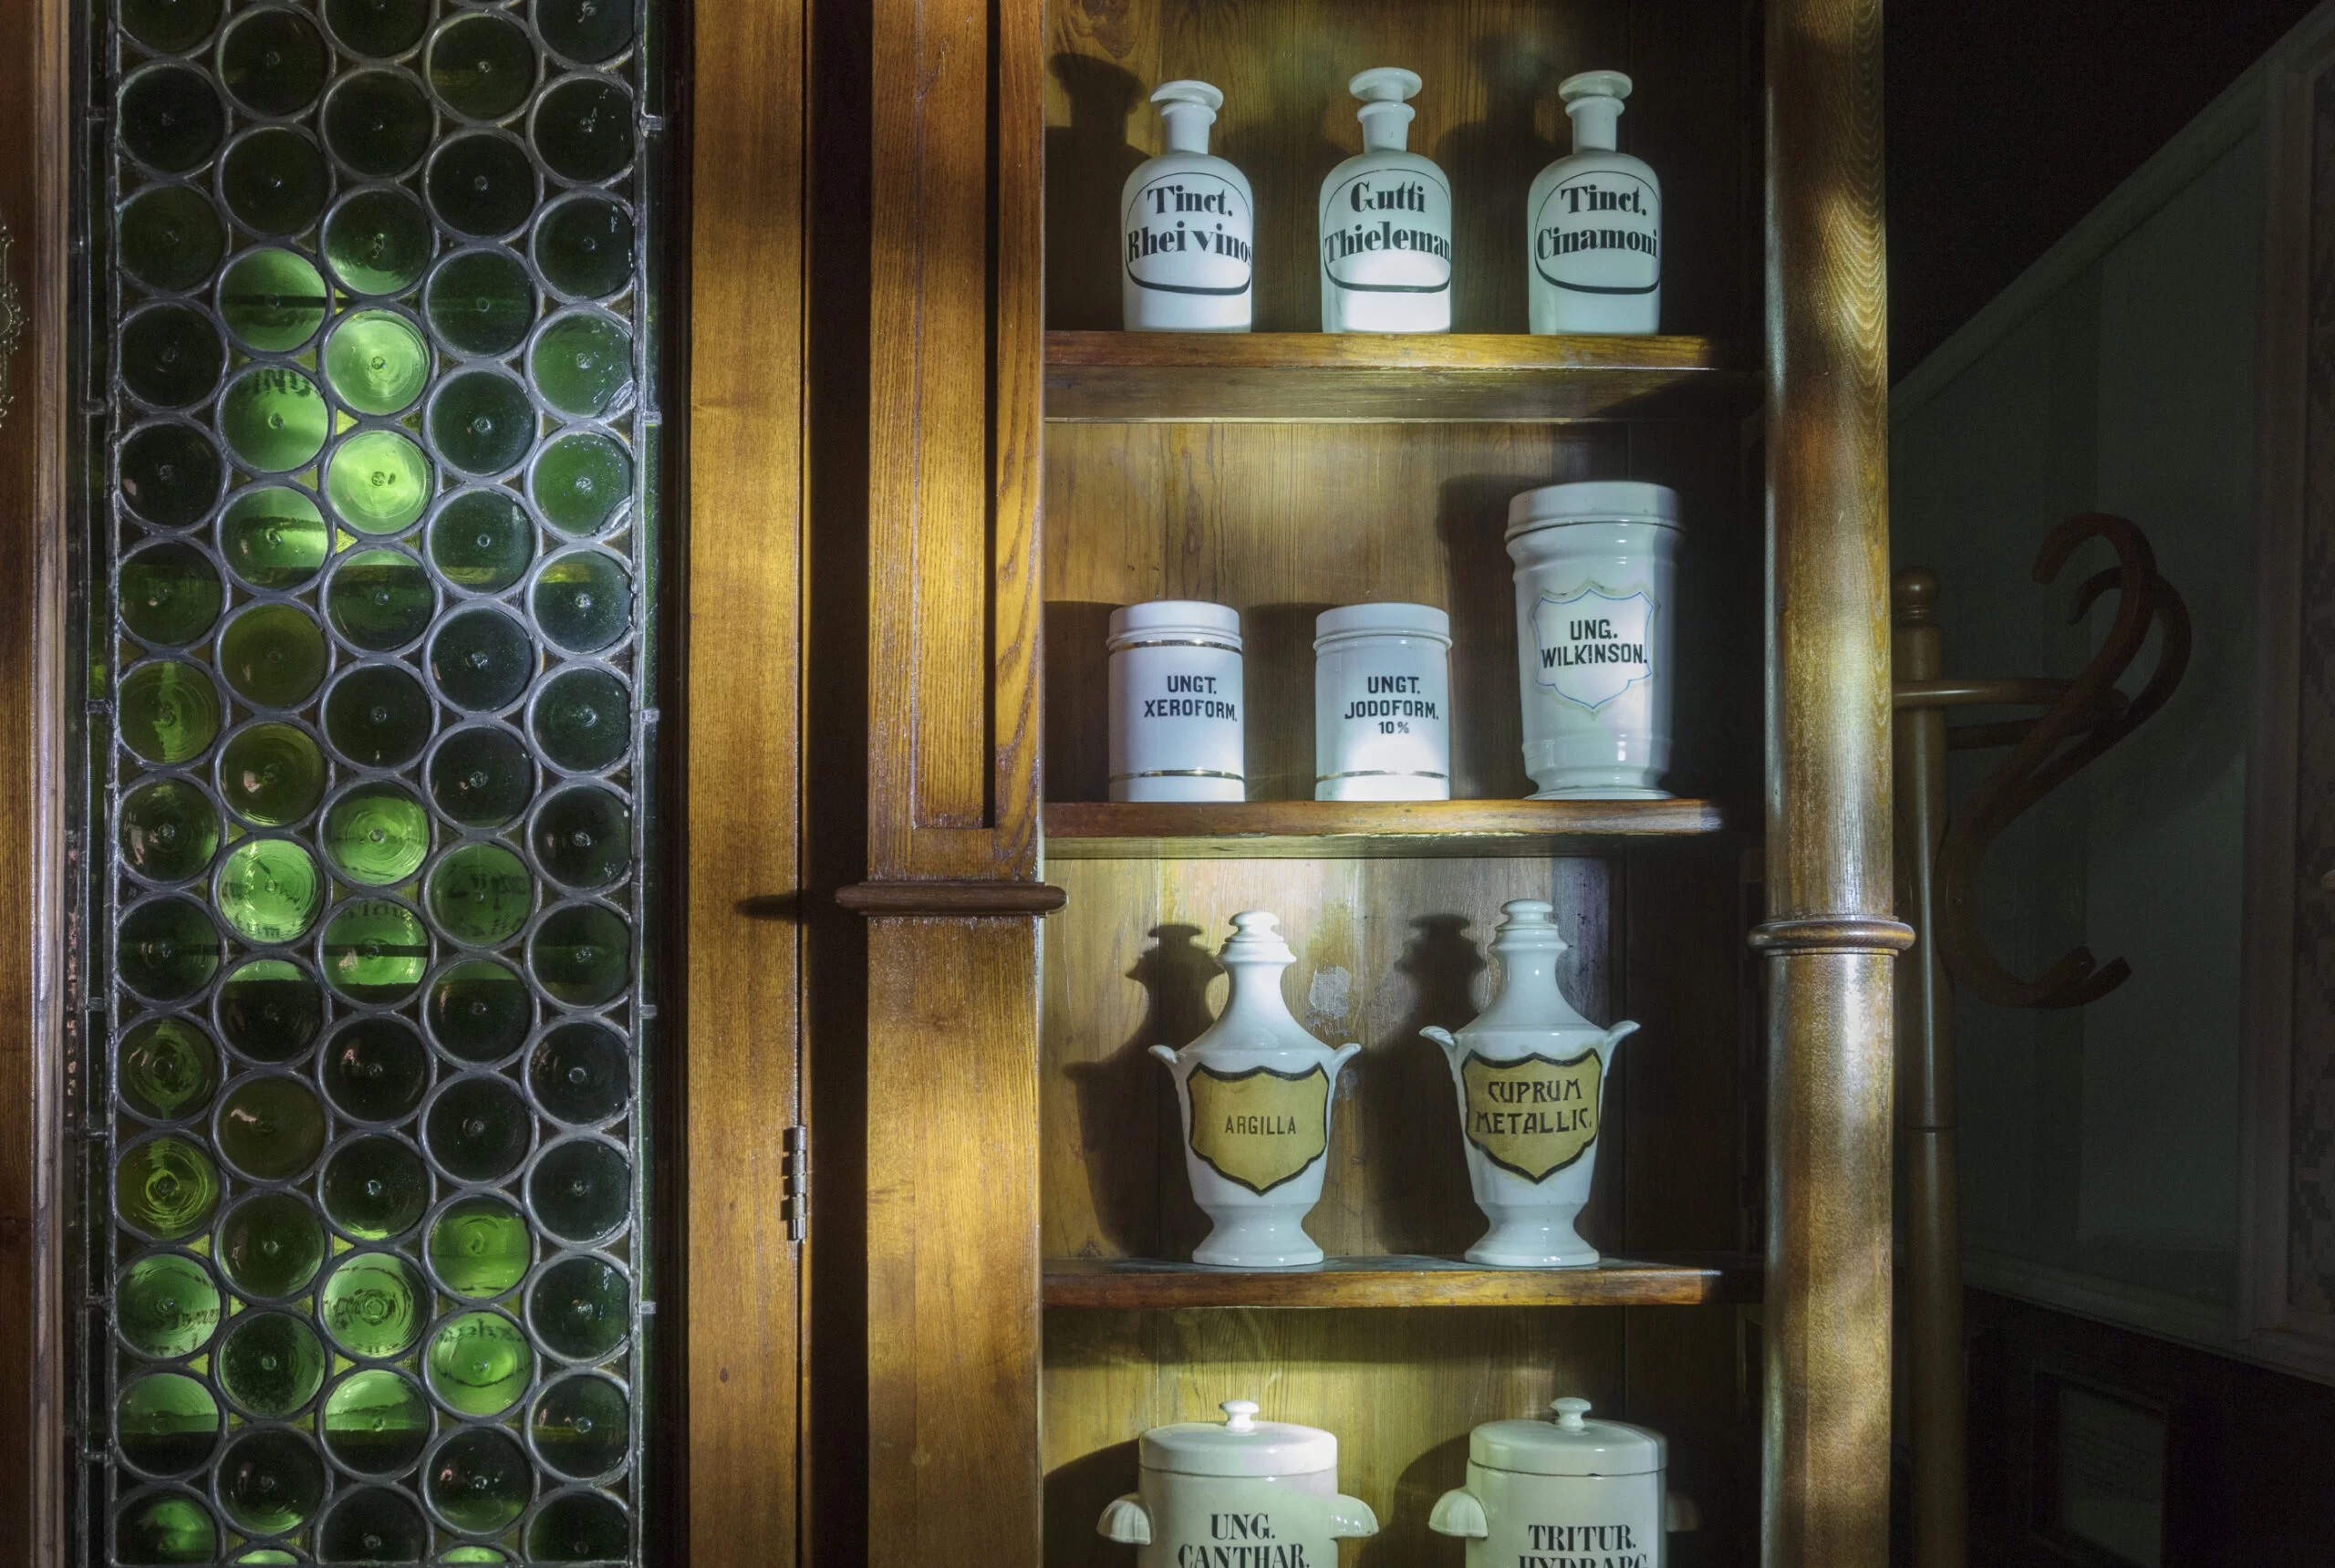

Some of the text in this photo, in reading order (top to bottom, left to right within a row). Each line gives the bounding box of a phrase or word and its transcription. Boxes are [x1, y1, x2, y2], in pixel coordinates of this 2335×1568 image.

[1147, 184, 1233, 217] Tinct.
[1350, 181, 1426, 213] Gutti
[1561, 183, 1647, 216] Tinct.
[1127, 221, 1188, 264] Rhei
[1537, 227, 1657, 260] Cinamoni
[1570, 618, 1618, 640] UNG.
[1541, 643, 1648, 669] WILKINSON.
[1167, 675, 1218, 694] UNGT.
[1367, 676, 1420, 694] UNGT.
[1144, 699, 1238, 722] XEROFORM.
[1344, 700, 1439, 720] JODOFORM.
[1488, 1078, 1583, 1104] CUPRUM
[1224, 1116, 1296, 1136] ARGILLA
[1209, 1512, 1276, 1540] UNG.
[1528, 1523, 1636, 1552] TRITUR.
[1178, 1542, 1310, 1568] CANTHAR.
